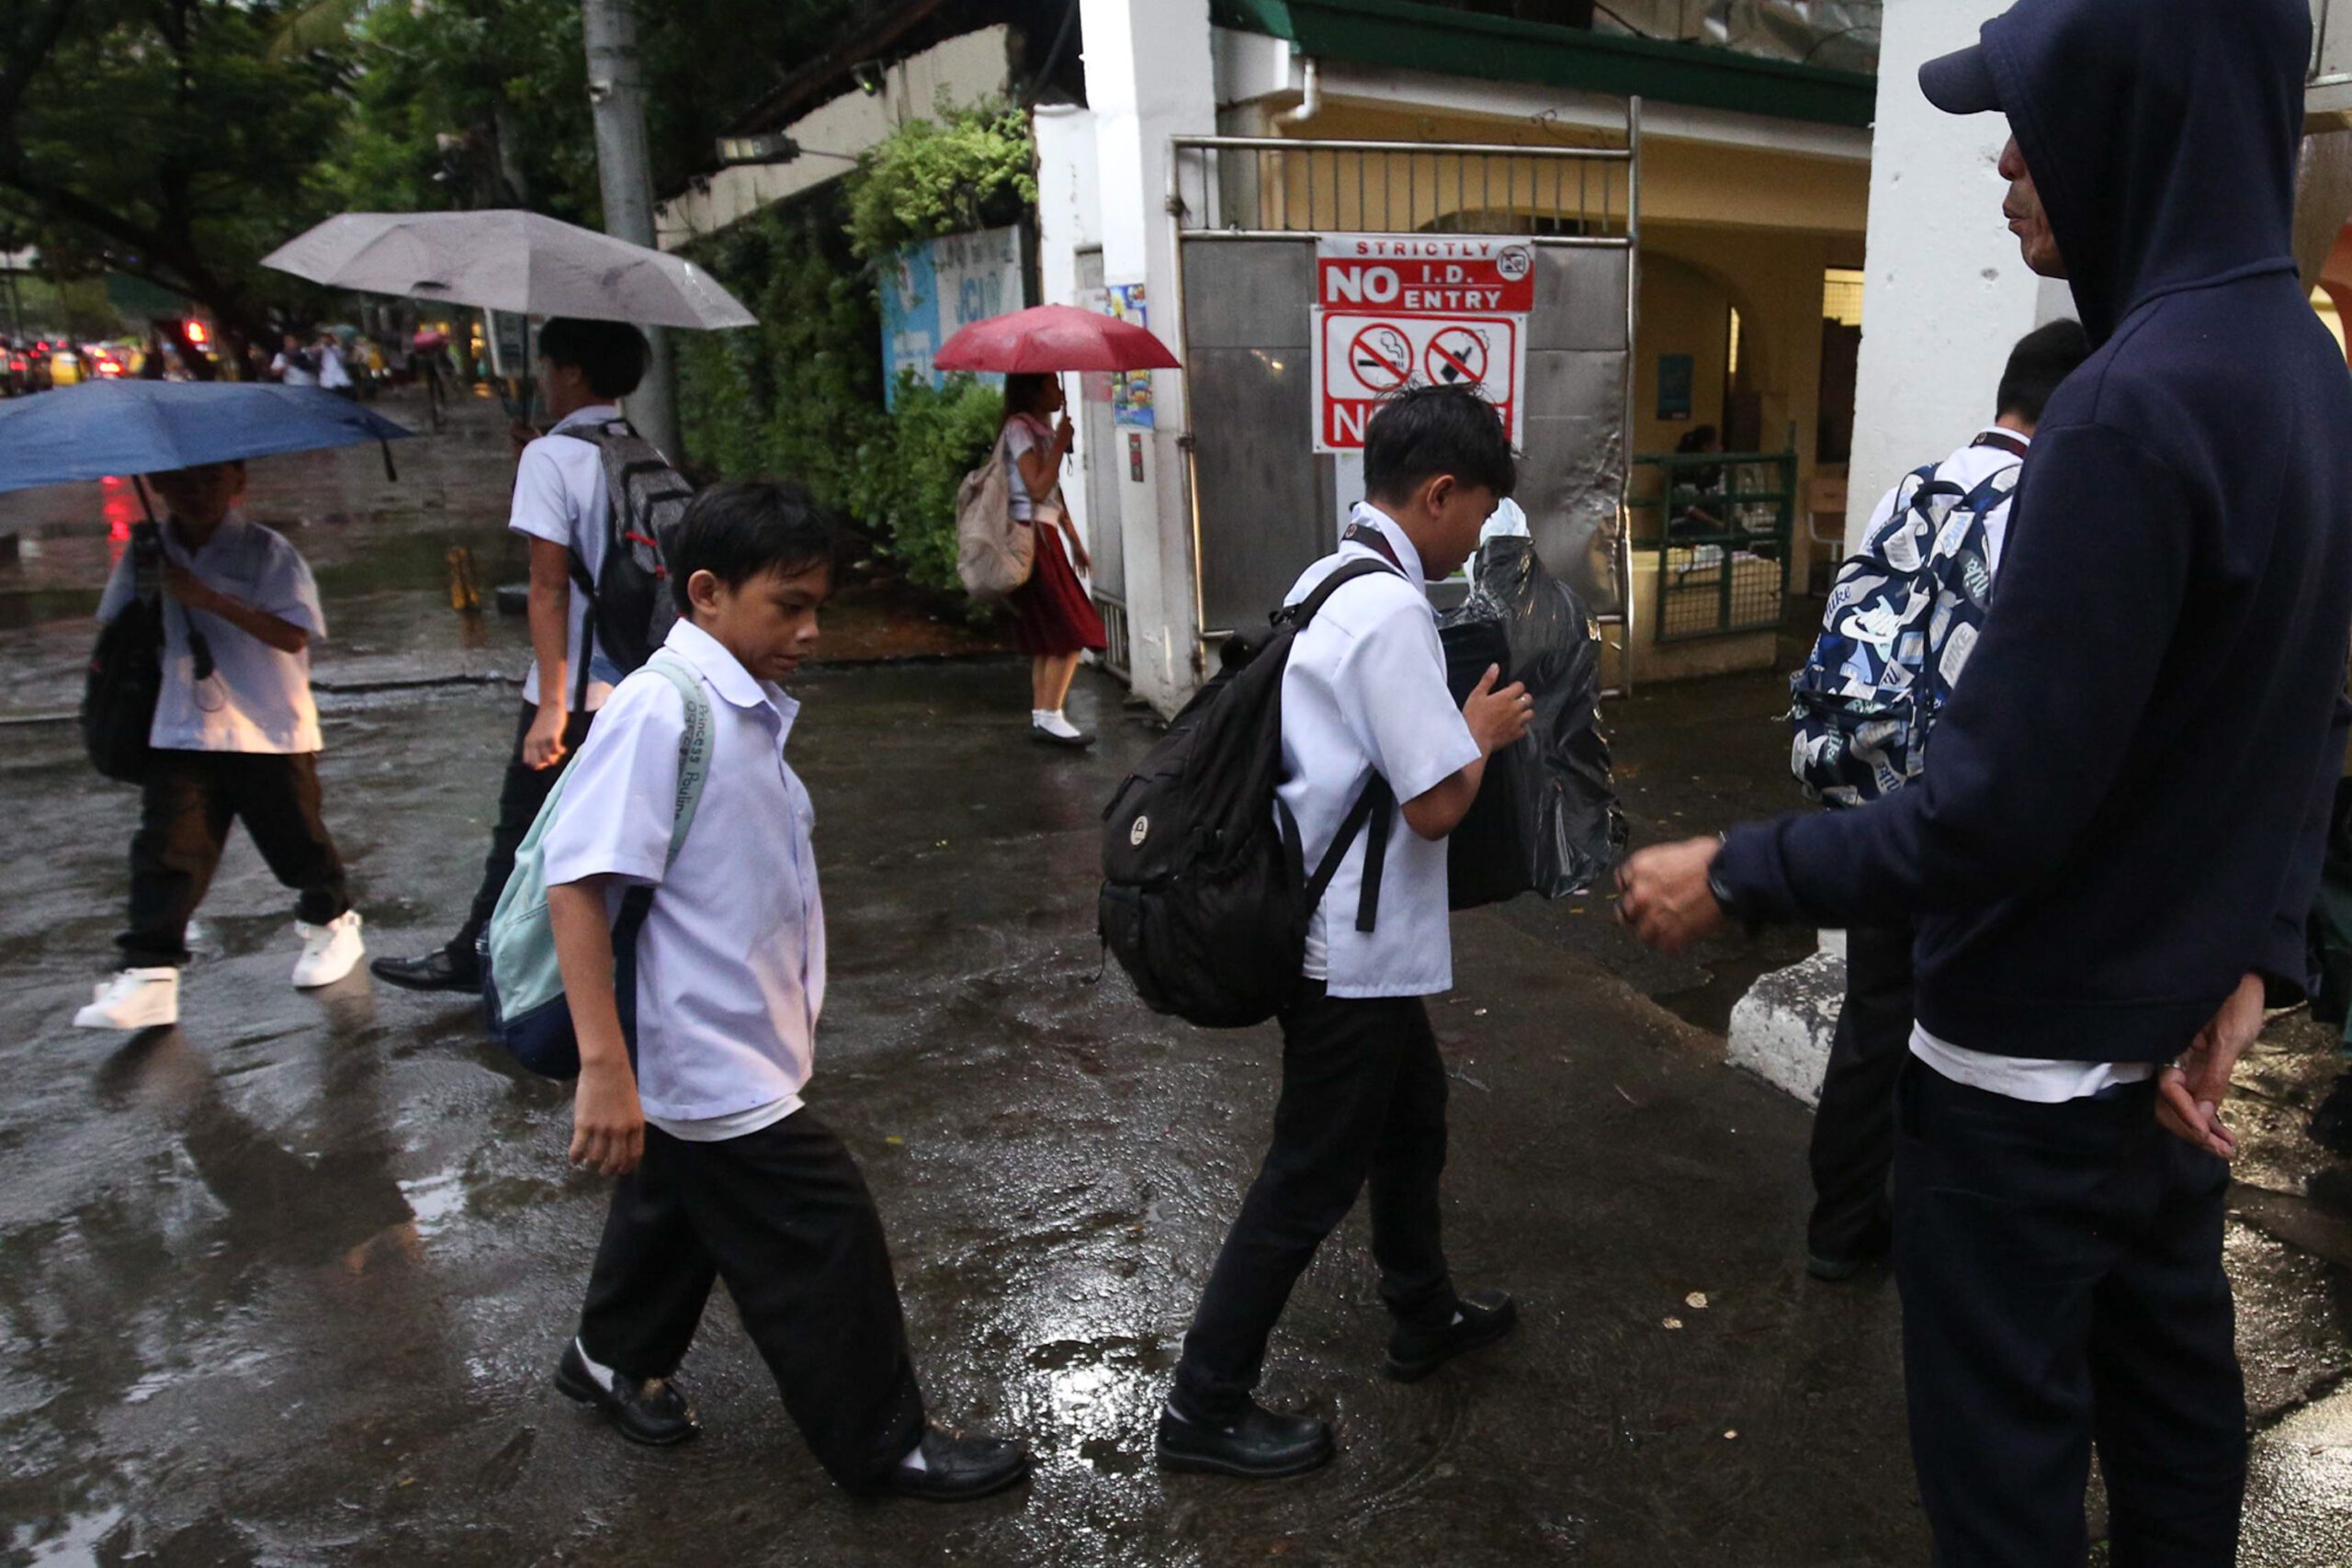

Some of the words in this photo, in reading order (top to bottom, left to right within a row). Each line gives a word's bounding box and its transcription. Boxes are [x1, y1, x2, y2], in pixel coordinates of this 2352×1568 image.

[1356, 242, 1490, 257] STRICTLY
[1326, 265, 1400, 303] NO
[1422, 265, 1474, 284] I.D.
[1405, 290, 1502, 309] ENTRY
[1333, 402, 1374, 442] N
[690, 704, 709, 764] Princess
